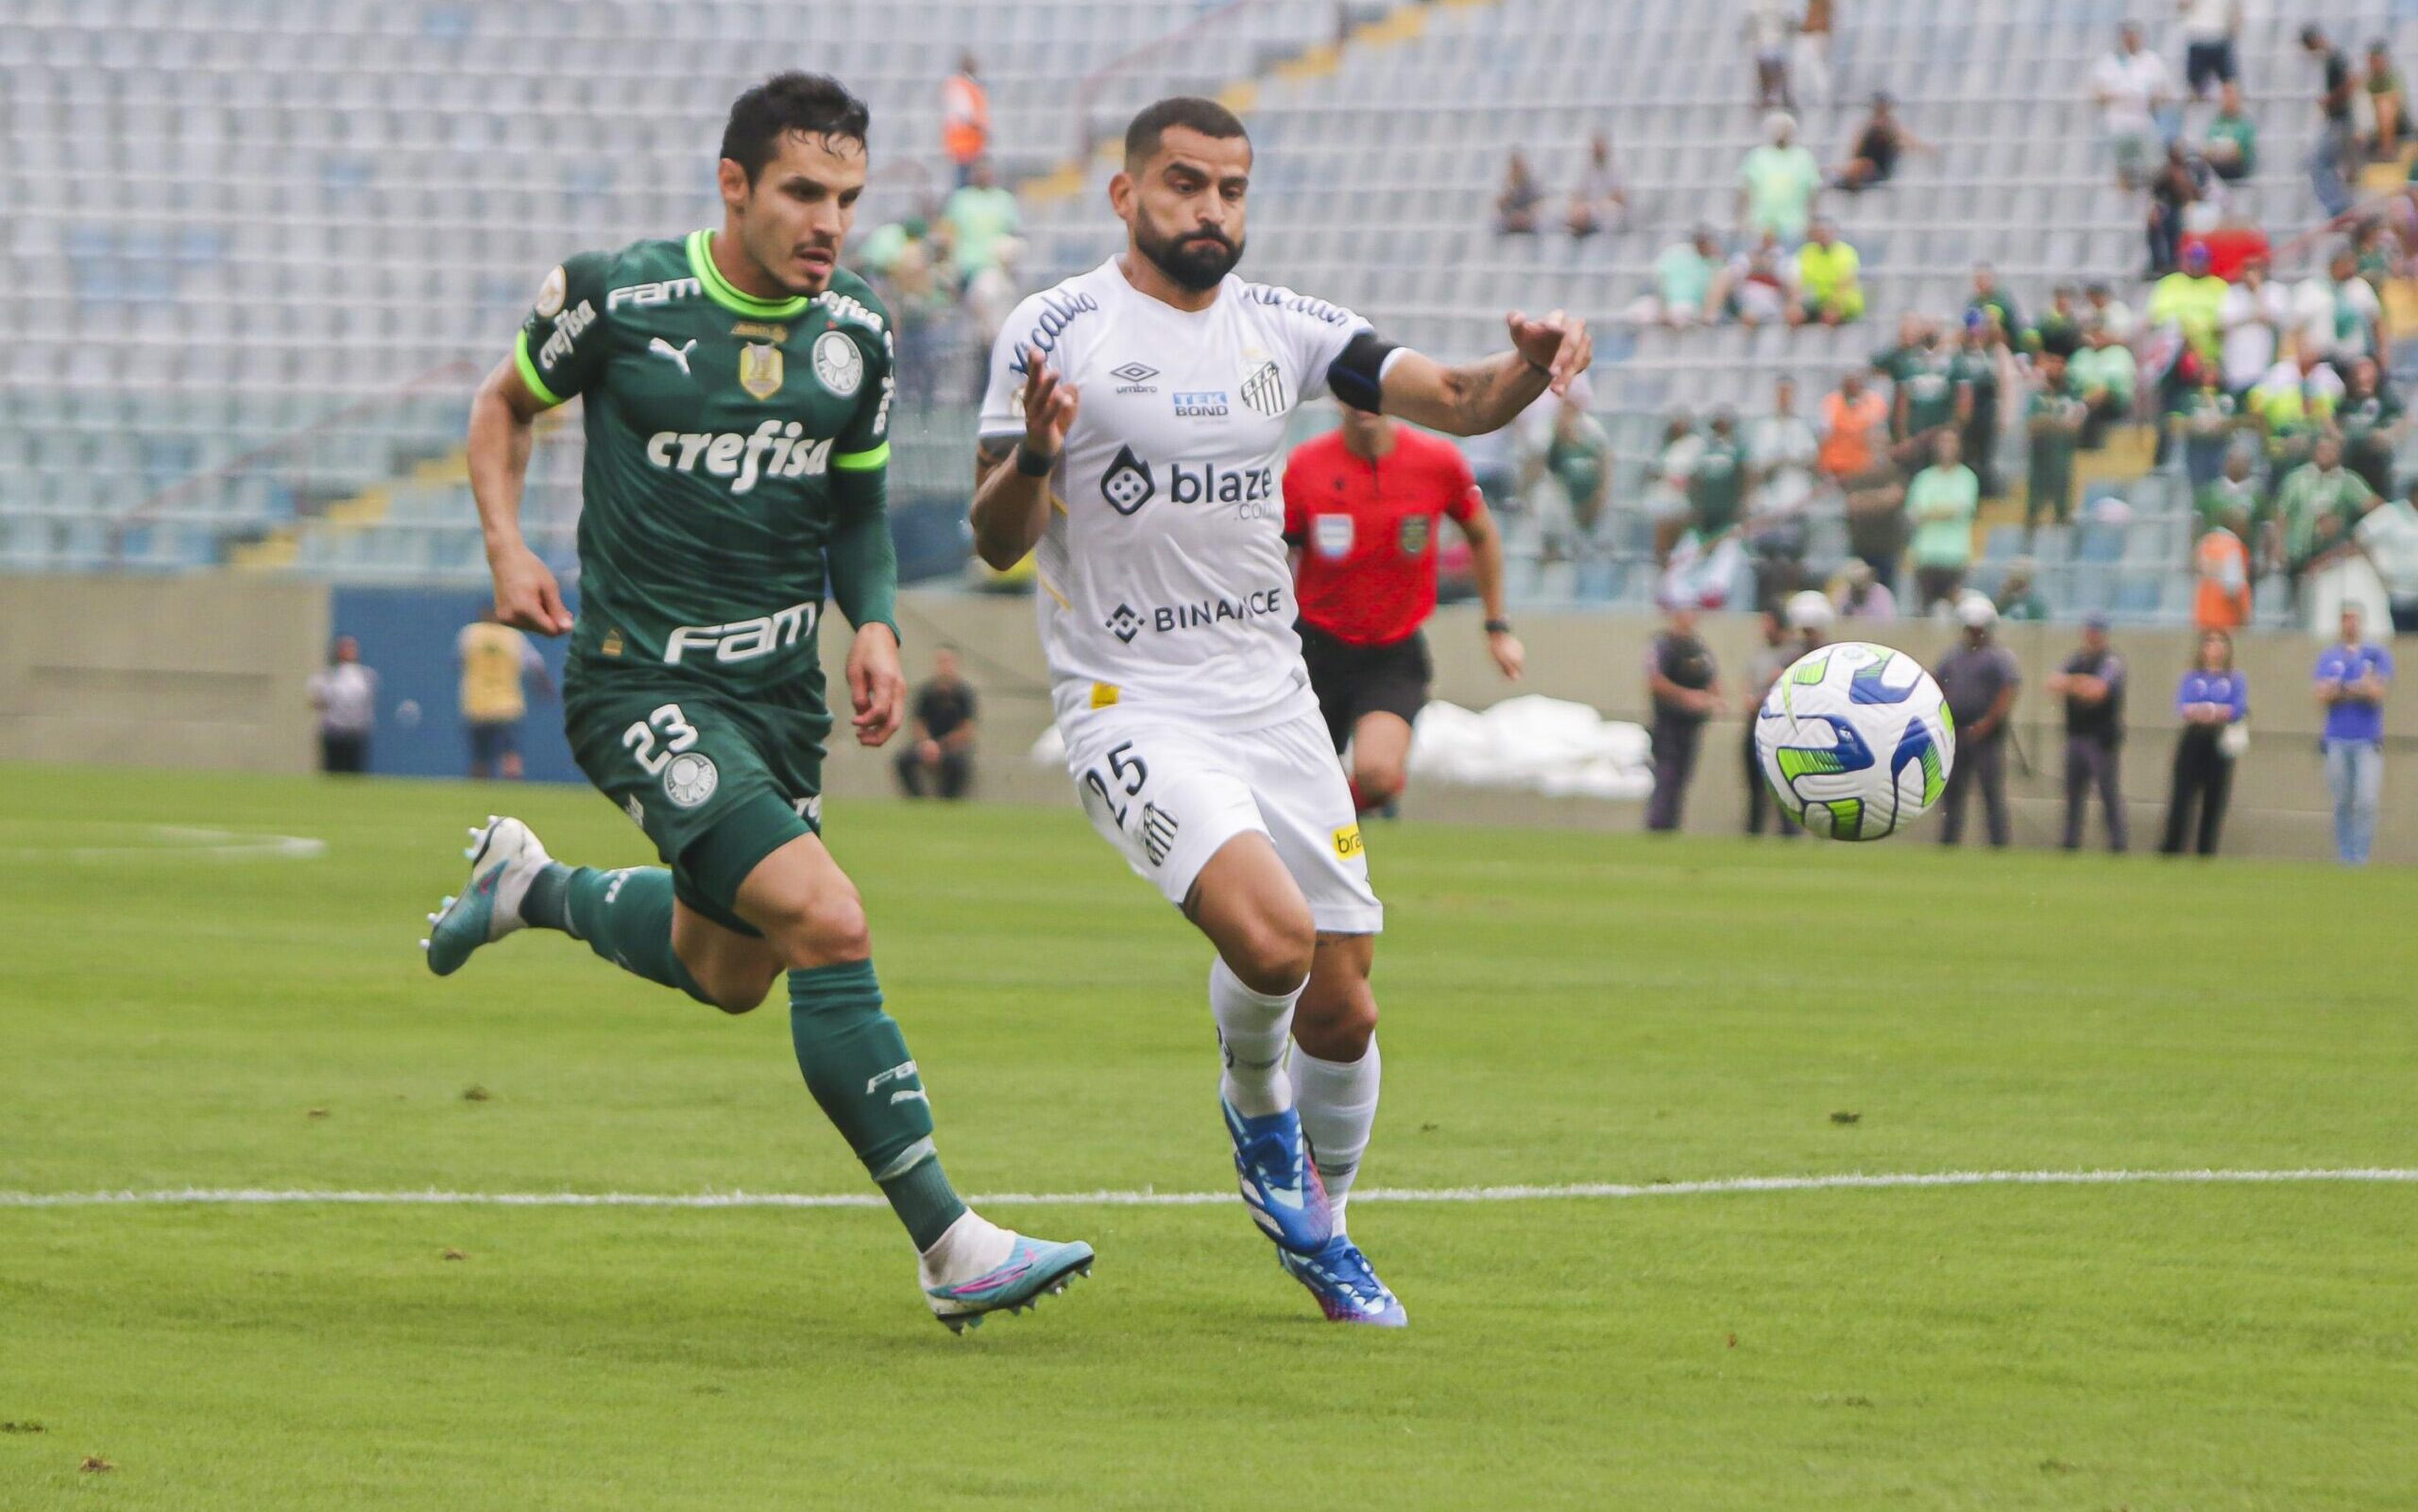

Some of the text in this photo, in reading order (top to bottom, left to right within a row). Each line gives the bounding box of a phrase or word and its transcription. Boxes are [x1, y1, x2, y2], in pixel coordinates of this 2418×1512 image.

[540, 298, 597, 370] crefisa
[1116, 383, 1158, 395] umbro
[1173, 392, 1228, 405] TEK
[1175, 405, 1229, 416] BOND
[647, 421, 837, 495] crefisa
[1170, 463, 1272, 504] blaze
[1155, 588, 1281, 633] BINANCE
[622, 703, 699, 776] 23
[1086, 739, 1149, 832] 25
[1337, 832, 1361, 854] bra
